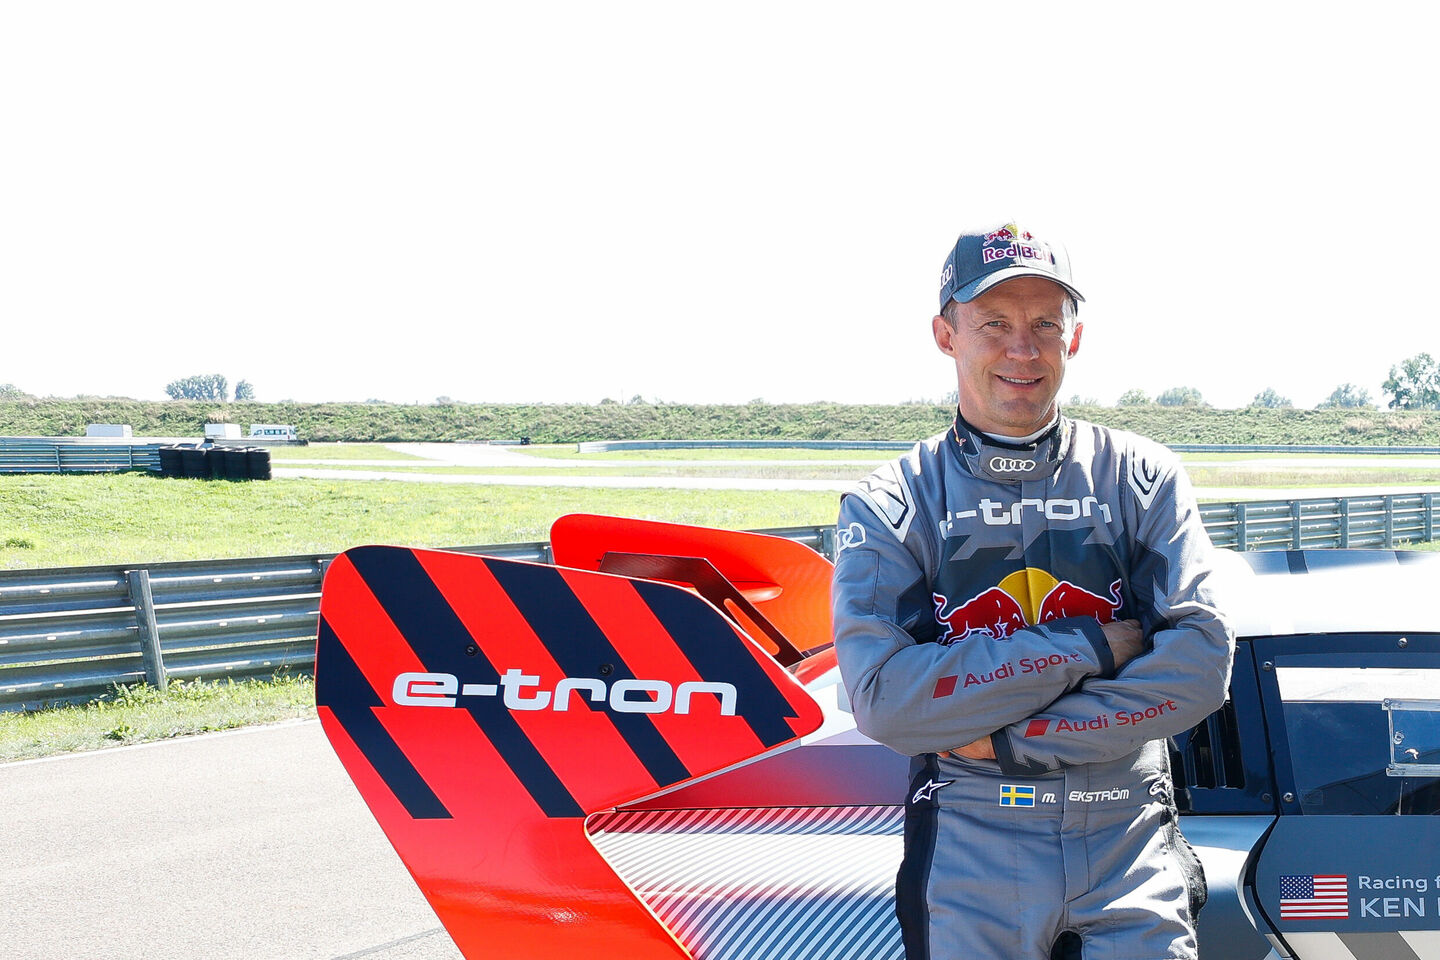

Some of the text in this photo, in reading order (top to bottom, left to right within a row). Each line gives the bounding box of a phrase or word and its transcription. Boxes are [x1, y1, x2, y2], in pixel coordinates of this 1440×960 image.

[983, 243, 1018, 263] Red
[963, 653, 1083, 688] Audi Sport
[391, 668, 738, 717] e-tron
[1055, 700, 1178, 733] Audi Sport
[1068, 787, 1130, 803] EKSTRÖM
[1358, 875, 1428, 893] Racing
[1360, 897, 1425, 918] KEN
